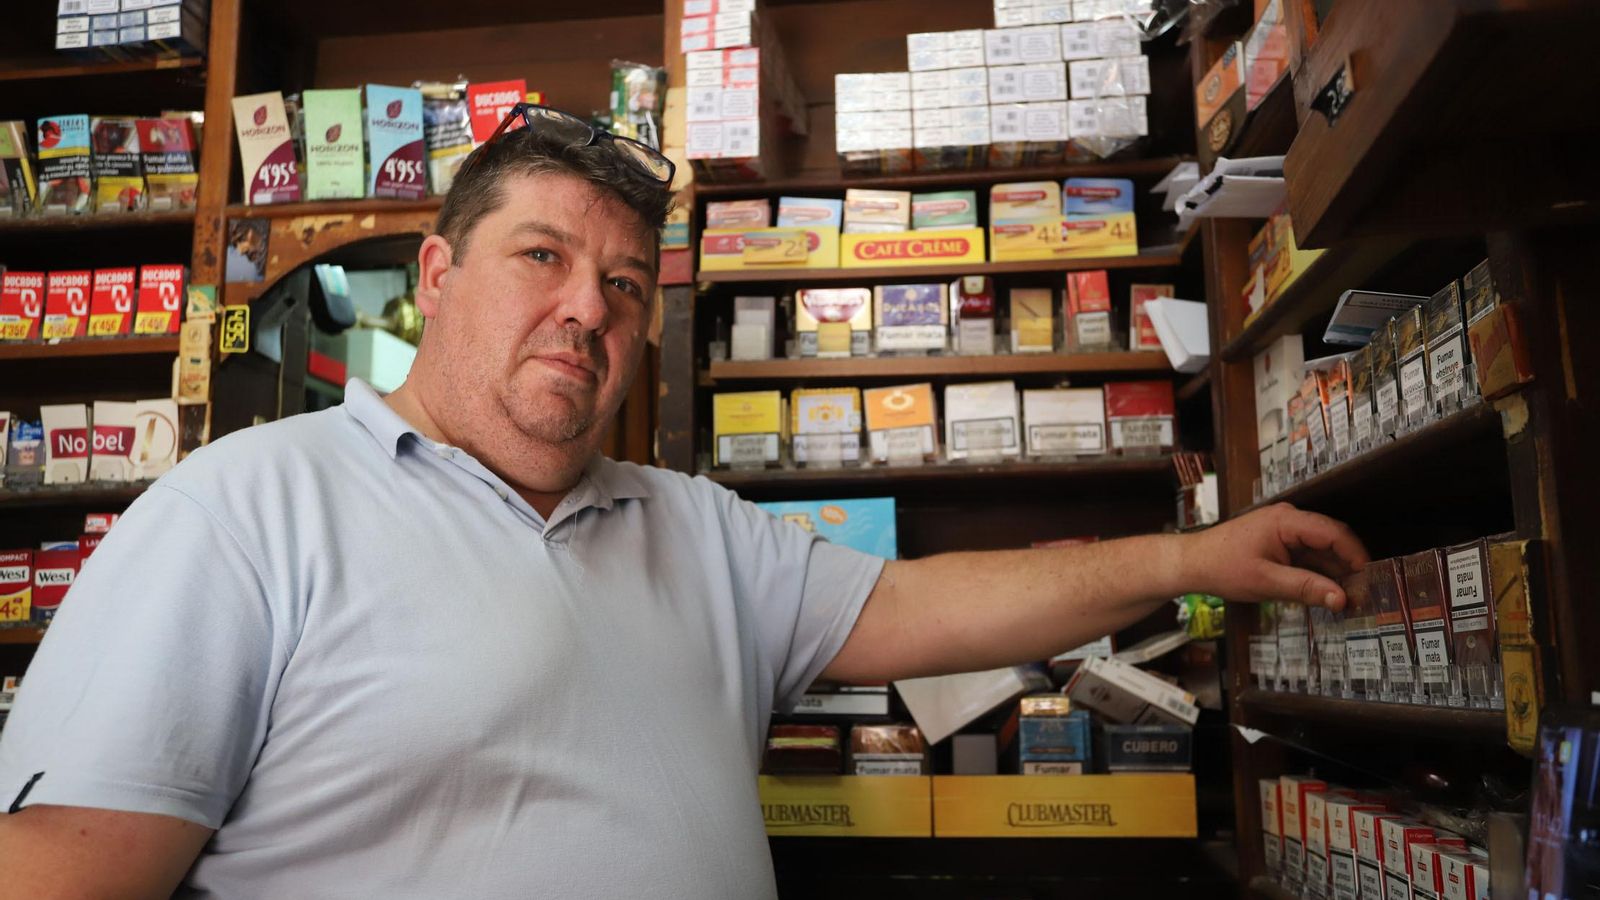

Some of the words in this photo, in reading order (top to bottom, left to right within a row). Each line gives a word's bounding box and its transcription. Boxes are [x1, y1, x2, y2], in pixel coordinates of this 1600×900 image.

[241, 124, 286, 138] HORIZON
[372, 117, 420, 132] HORIZON
[310, 144, 359, 153] HORIZON
[4, 276, 43, 288] DUCADOS
[50, 274, 90, 287] DUCADOS
[95, 272, 134, 285] DUCADOS
[142, 268, 181, 283] DUCADOS
[1436, 348, 1455, 365] Fumar
[1033, 430, 1069, 440] Fumar
[1071, 429, 1098, 439] mata
[0, 553, 28, 562] OMPACT
[38, 571, 71, 583] West
[1386, 640, 1404, 652] Fumar
[1420, 637, 1441, 650] Fumar
[1391, 653, 1406, 665] mata
[1425, 651, 1441, 663] mata
[1122, 740, 1178, 753] CUBERO
[1034, 764, 1071, 775] Fumar
[762, 804, 855, 827] LUBMASTER
[1006, 802, 1118, 828] CLUBMASTER
